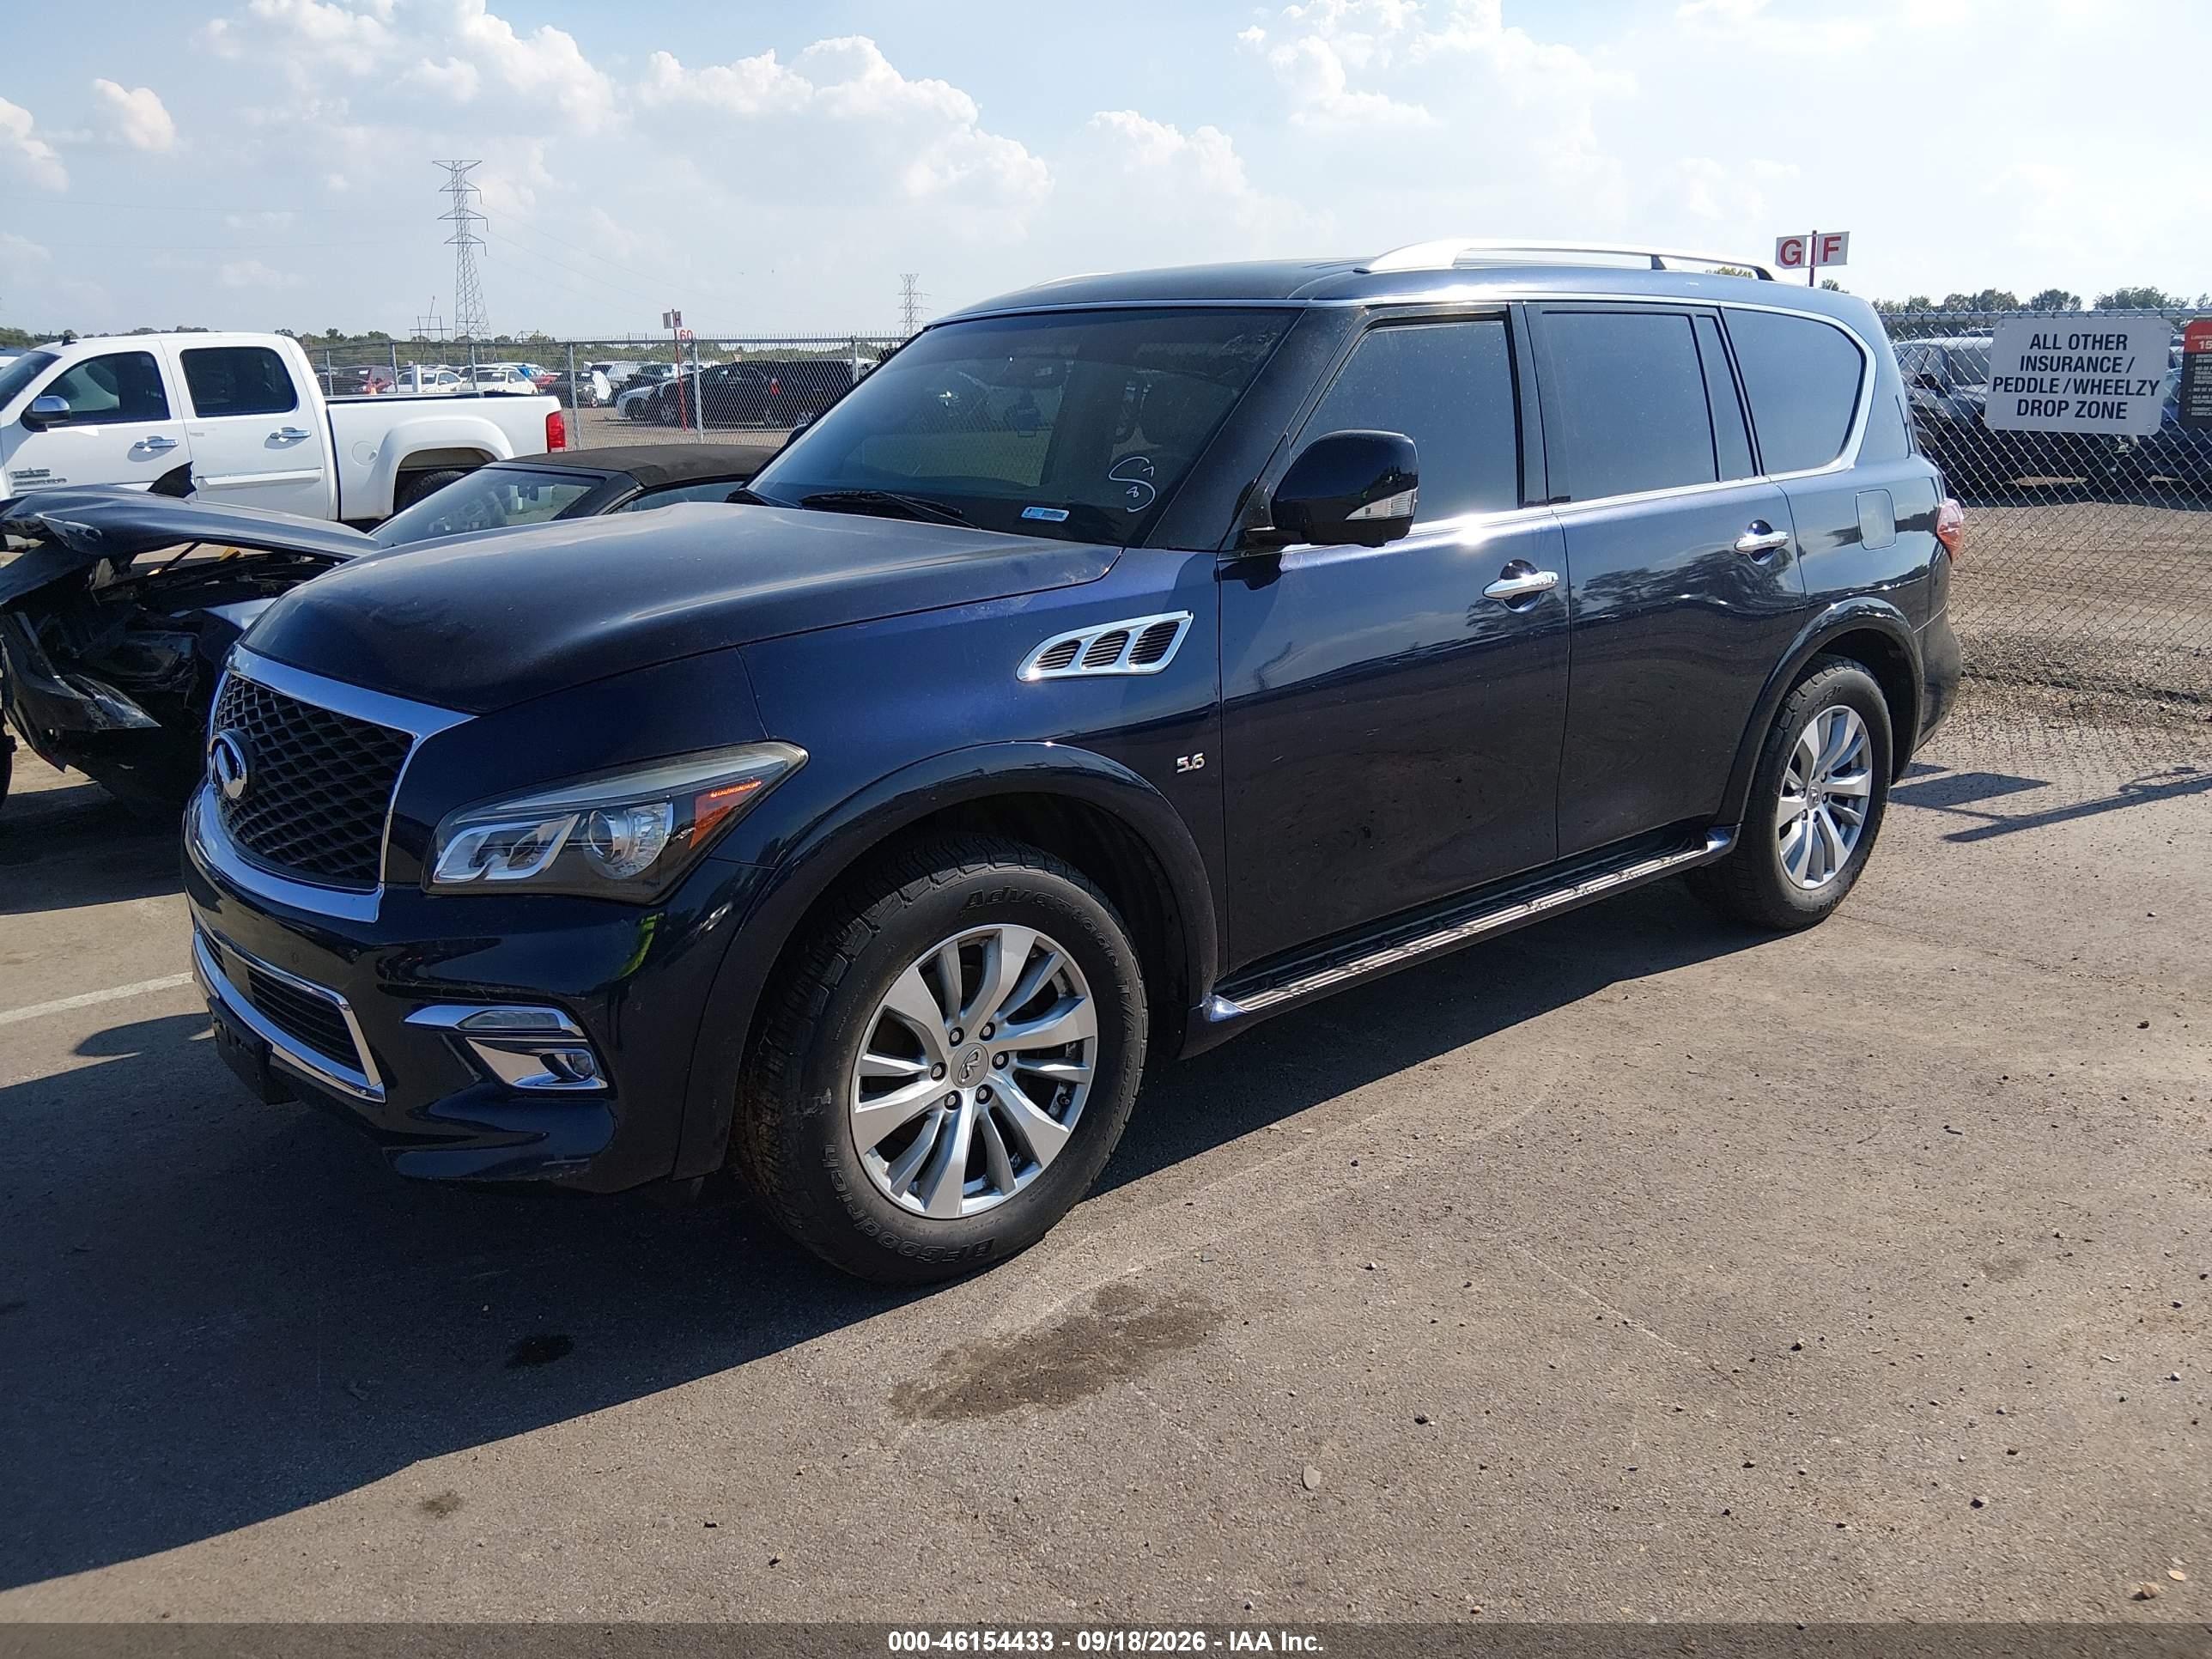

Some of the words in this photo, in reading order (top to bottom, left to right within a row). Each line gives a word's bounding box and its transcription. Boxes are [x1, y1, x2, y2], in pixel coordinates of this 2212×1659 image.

[1780, 239, 1802, 265] G
[1822, 236, 1842, 262] F
[674, 312, 681, 325] H
[679, 330, 693, 342] 60
[2029, 333, 2063, 350] ALL
[2068, 333, 2128, 351] OTHER
[2020, 355, 2124, 373] INSURANCE
[1992, 376, 2060, 394] PEDDLE
[2016, 398, 2069, 417] DROP
[2074, 400, 2128, 420] ZONE
[1176, 752, 1206, 774] 5.6
[823, 1143, 997, 1264] BFGoodrich
